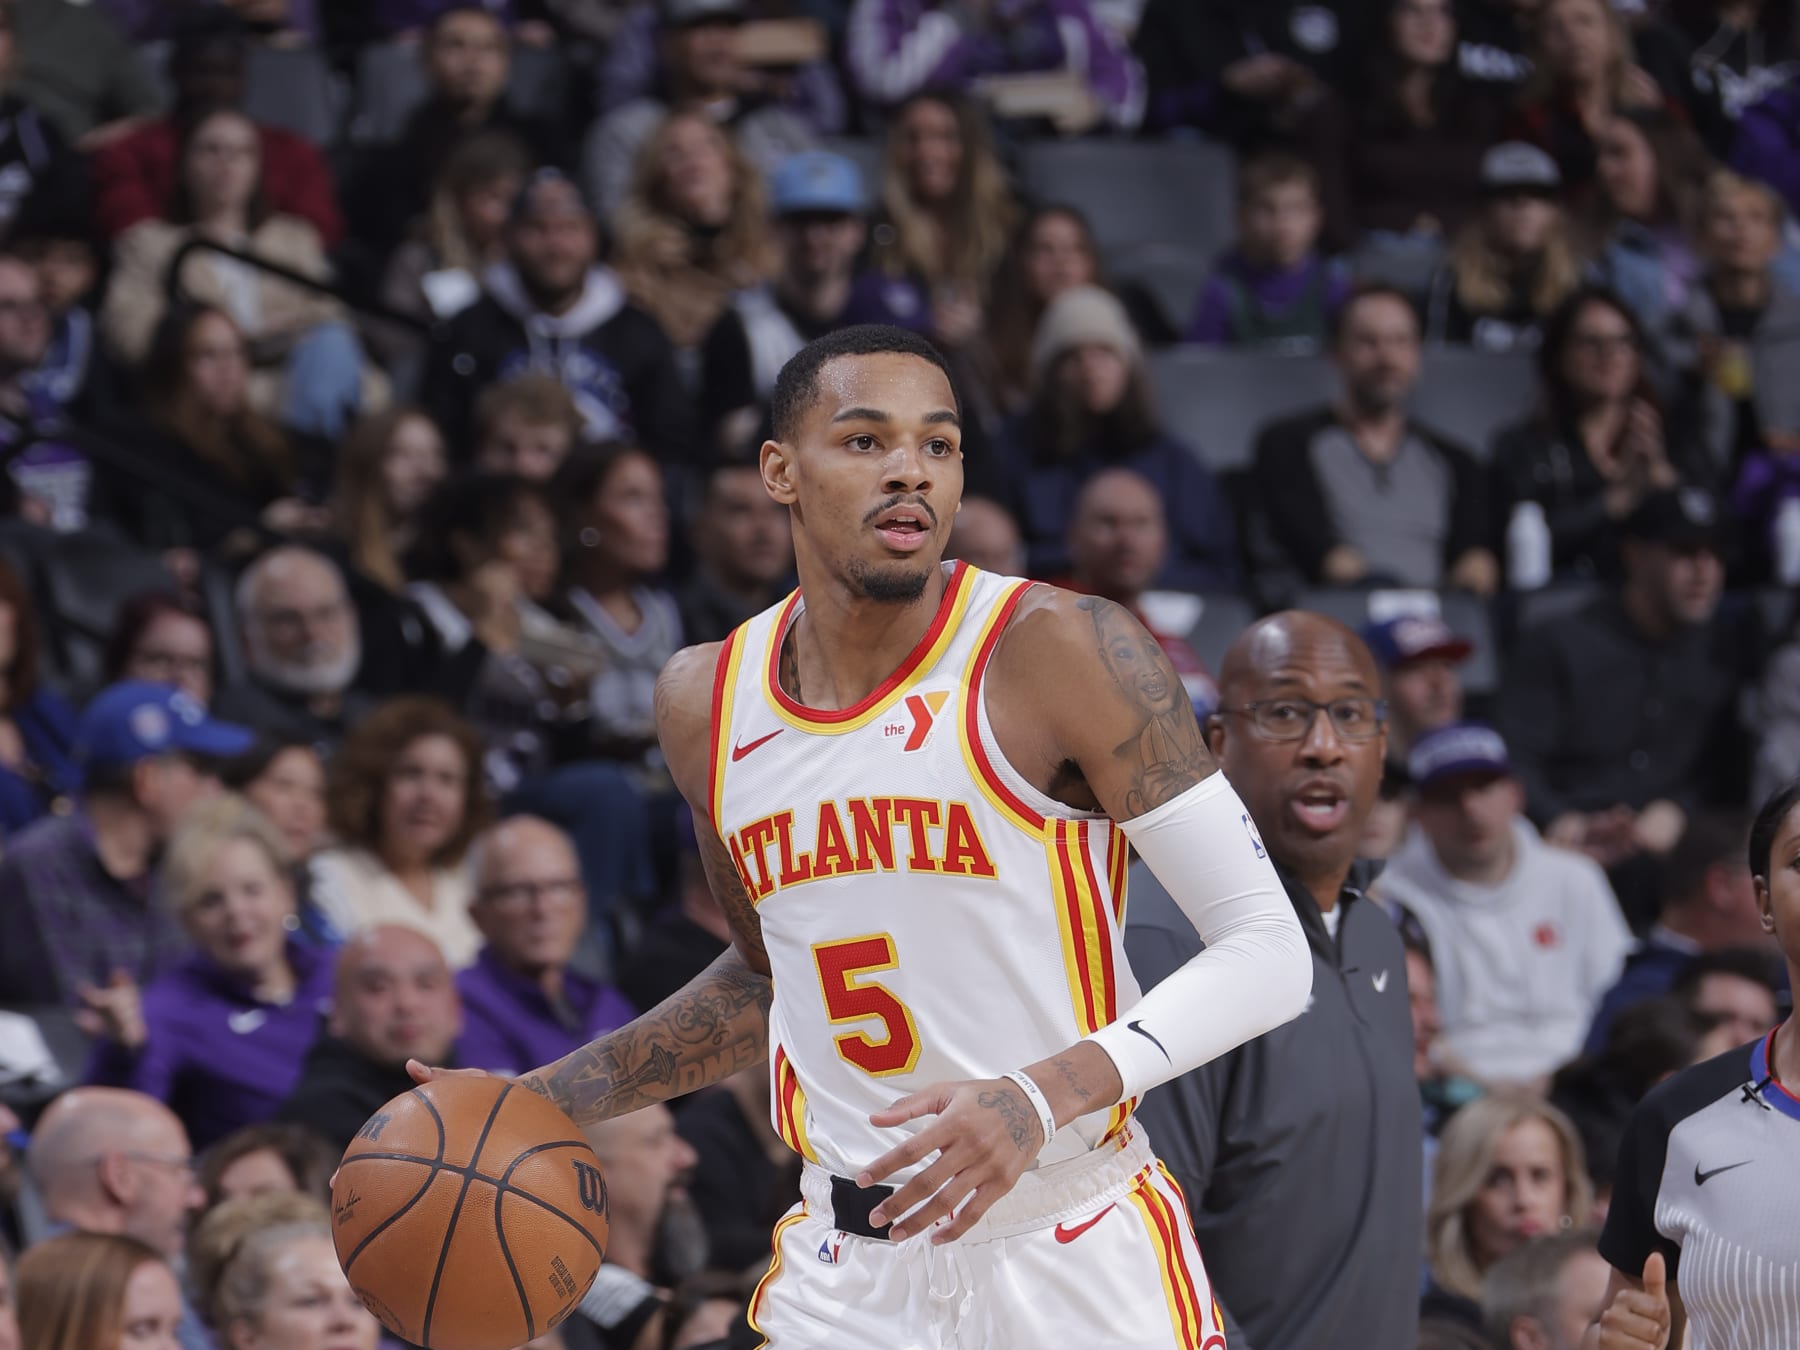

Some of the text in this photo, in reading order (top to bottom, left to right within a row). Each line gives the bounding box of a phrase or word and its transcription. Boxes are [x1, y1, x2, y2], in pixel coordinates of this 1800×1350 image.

[884, 724, 905, 737] the
[725, 796, 999, 907] ATLANTA
[811, 931, 922, 1079] 5
